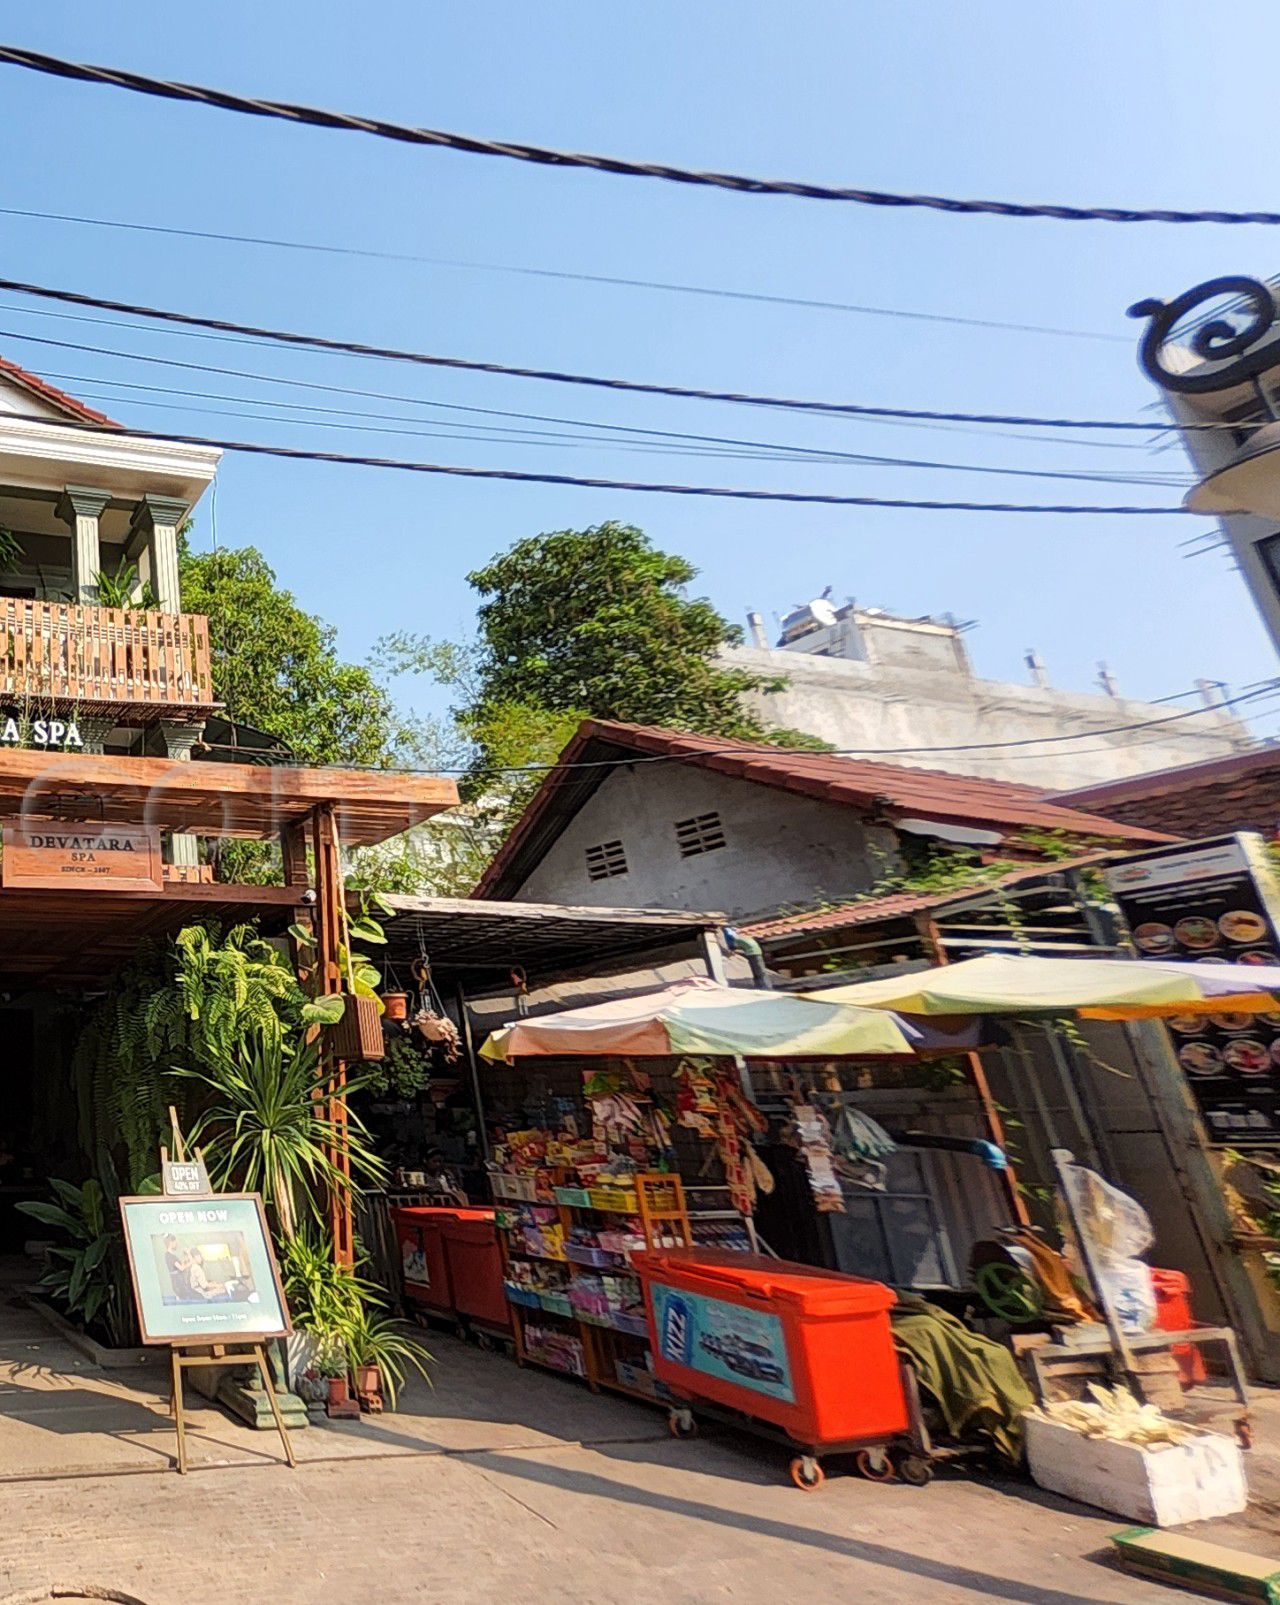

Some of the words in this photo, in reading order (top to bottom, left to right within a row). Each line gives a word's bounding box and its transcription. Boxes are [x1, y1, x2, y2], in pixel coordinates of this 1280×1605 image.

[34, 720, 84, 746] SPA
[29, 835, 135, 851] DEVATARA
[71, 852, 96, 862] SPA
[61, 865, 86, 873] SINCE
[171, 1166, 199, 1181] OPEN
[159, 1211, 194, 1224] OPEN
[196, 1209, 228, 1223] NOW
[665, 1306, 687, 1363] KIZZ
